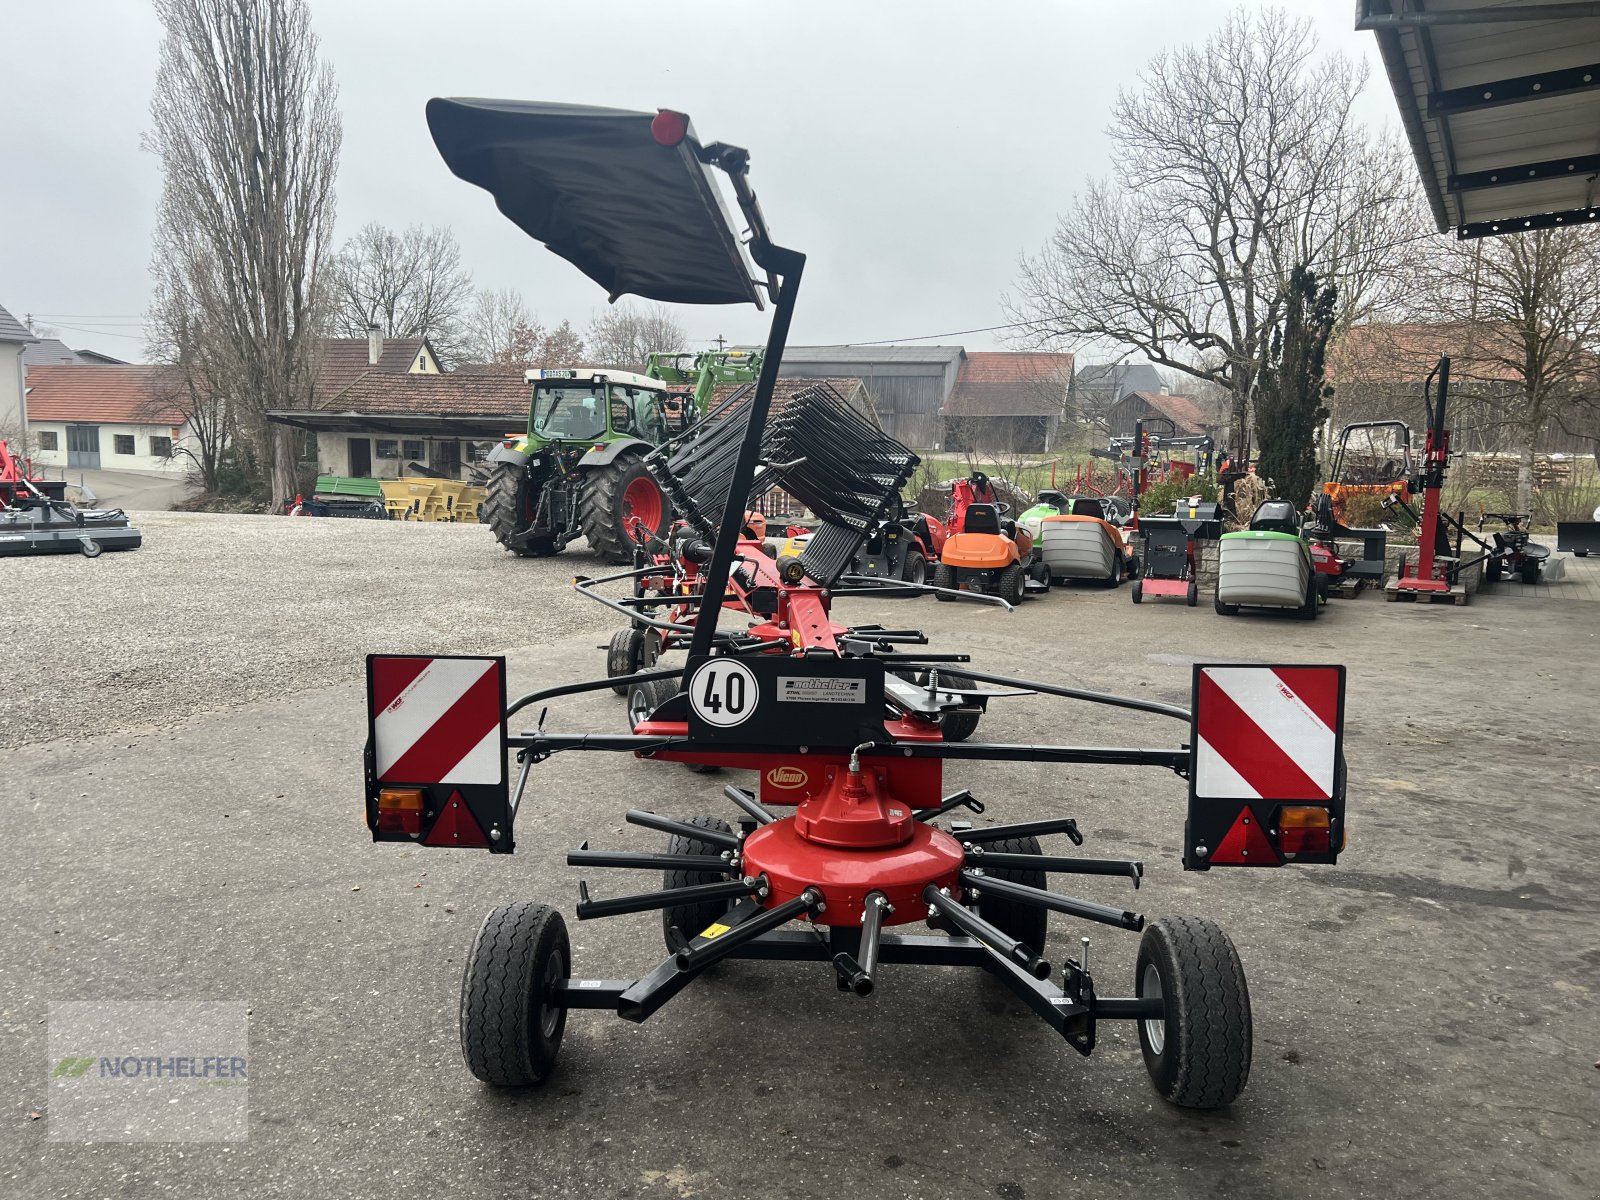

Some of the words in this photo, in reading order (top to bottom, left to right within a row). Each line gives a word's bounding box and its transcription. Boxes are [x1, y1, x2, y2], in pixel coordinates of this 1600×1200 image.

[536, 420, 544, 430] 40
[703, 671, 745, 714] 40
[773, 768, 803, 783] Vicon
